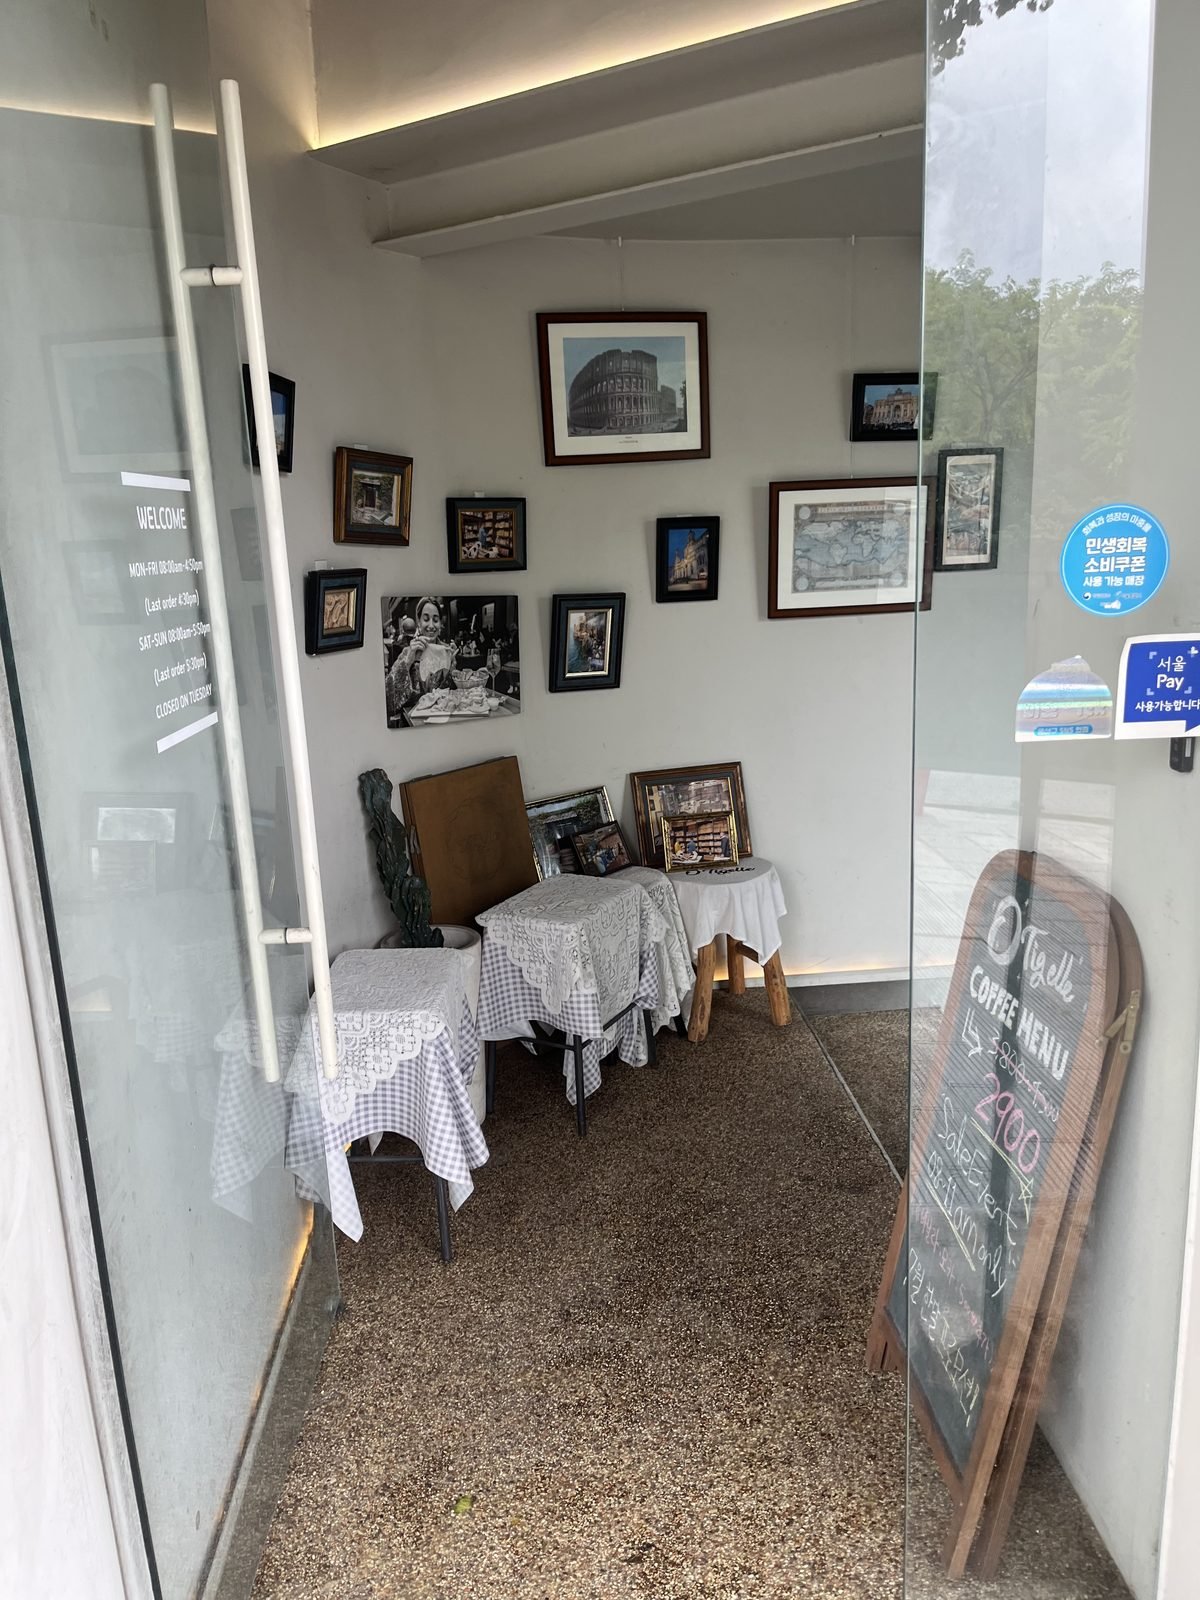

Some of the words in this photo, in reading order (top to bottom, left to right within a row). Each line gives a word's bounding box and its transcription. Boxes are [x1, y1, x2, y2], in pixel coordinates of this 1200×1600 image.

[136, 505, 187, 530] WELCOME
[1105, 512, 1130, 523] 성장의
[1086, 537, 1147, 555] 민생회복
[129, 562, 158, 578] MON-FRI
[1084, 556, 1146, 573] 소비쿠폰
[1083, 576, 1102, 587] 사용
[1104, 576, 1123, 586] 가능
[1125, 575, 1145, 586] 매장
[144, 597, 161, 616] (Last
[162, 594, 177, 611] order
[139, 634, 168, 651] SAT-SUN
[1157, 656, 1187, 672] 서울
[154, 668, 170, 687] (Last
[171, 662, 186, 677] order
[1156, 674, 1184, 691] Pay
[155, 697, 180, 719] CLOSED
[180, 692, 189, 708] ON
[189, 683, 212, 704] TUESDAY
[1135, 699, 1200, 713] 사용가능합니다
[969, 965, 1019, 1030] COFFEE
[1016, 1007, 1069, 1081] MENU
[975, 1072, 1041, 1174] 2900
